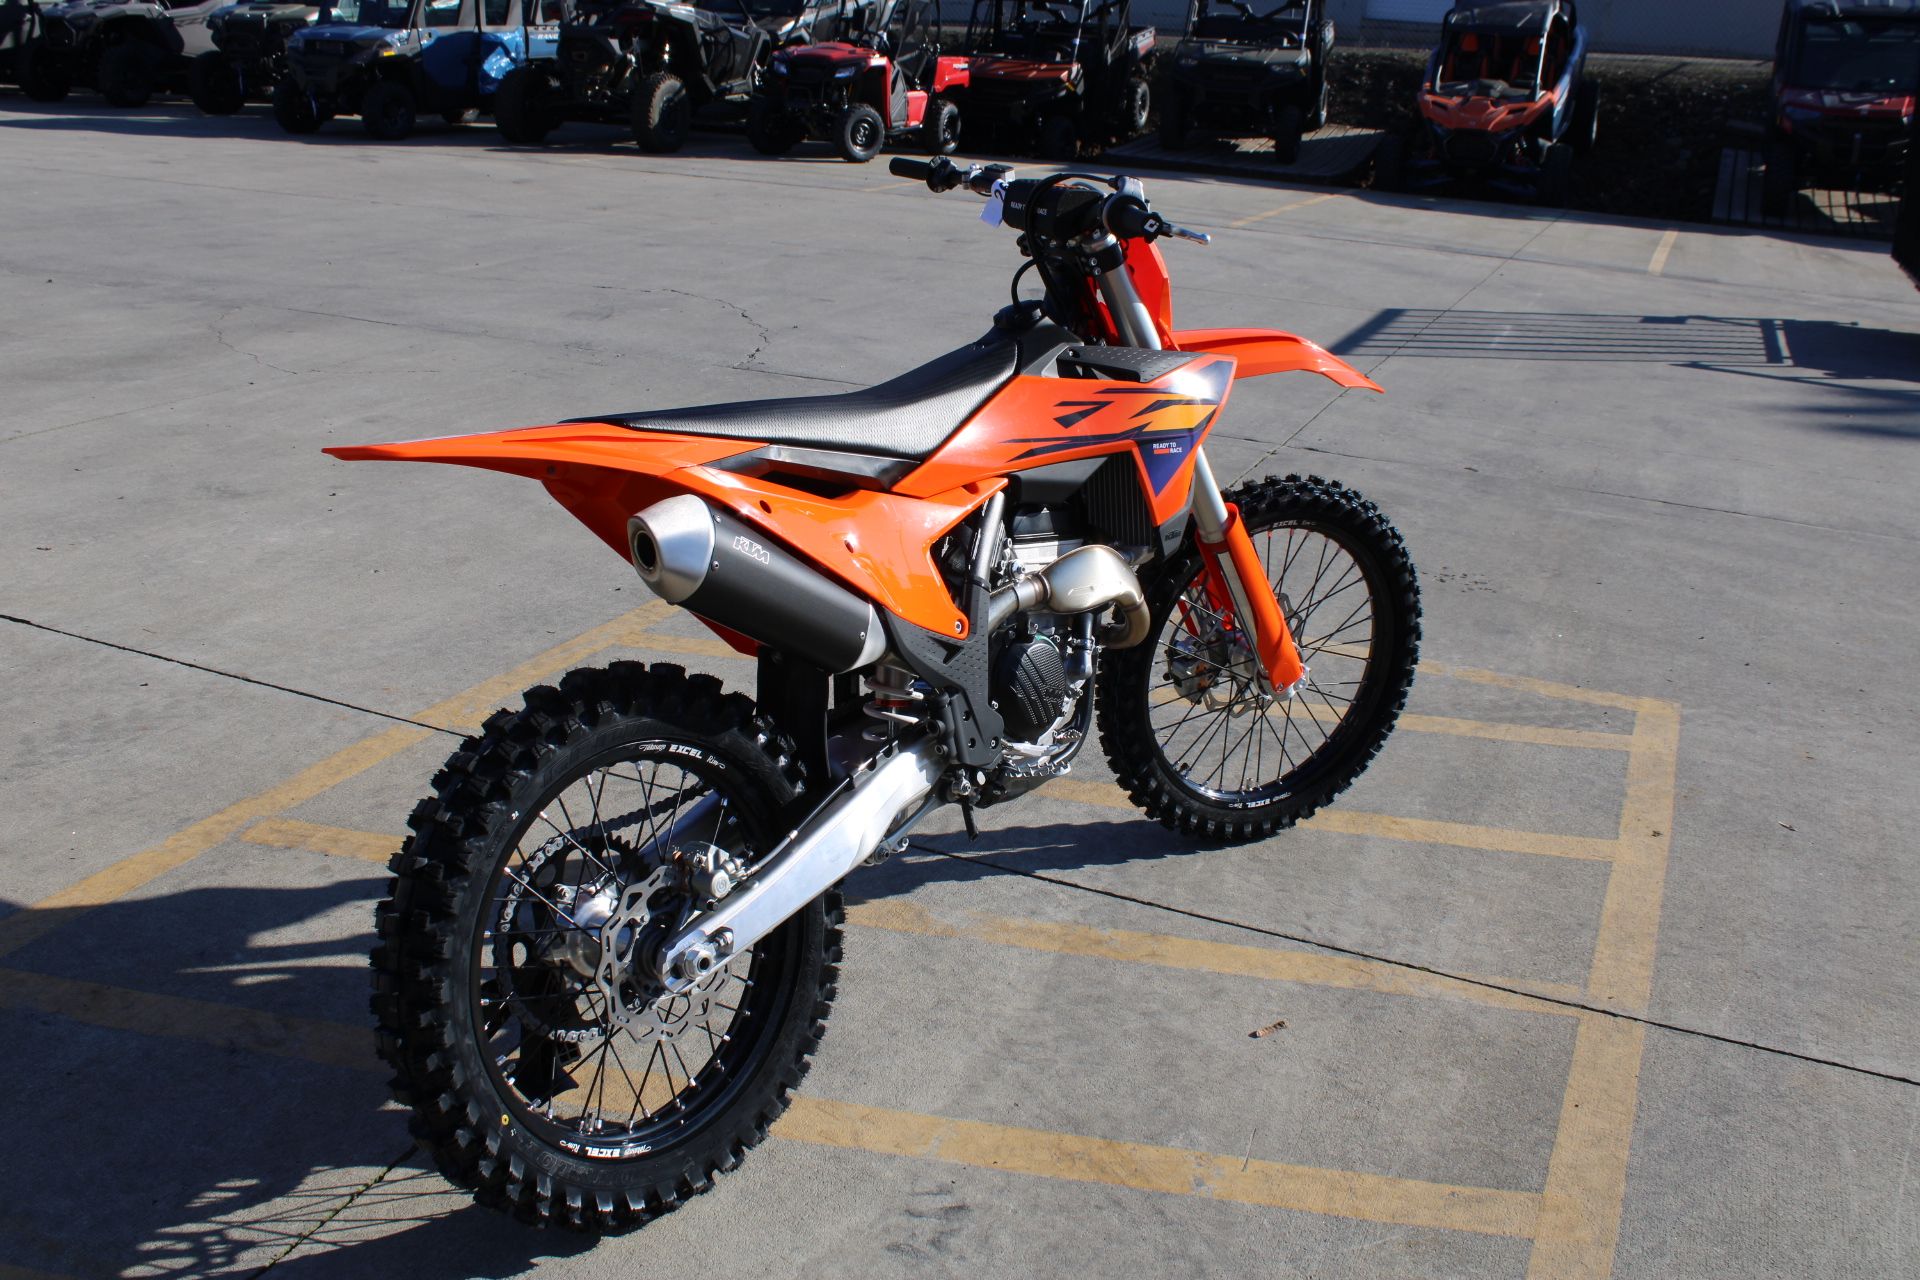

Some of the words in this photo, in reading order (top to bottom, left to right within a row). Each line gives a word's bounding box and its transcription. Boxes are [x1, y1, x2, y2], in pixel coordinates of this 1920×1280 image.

[1272, 519, 1298, 528] EXCEL
[733, 535, 770, 565] KTM
[668, 744, 703, 759] EXCEL
[585, 1146, 621, 1157] EXCEL
